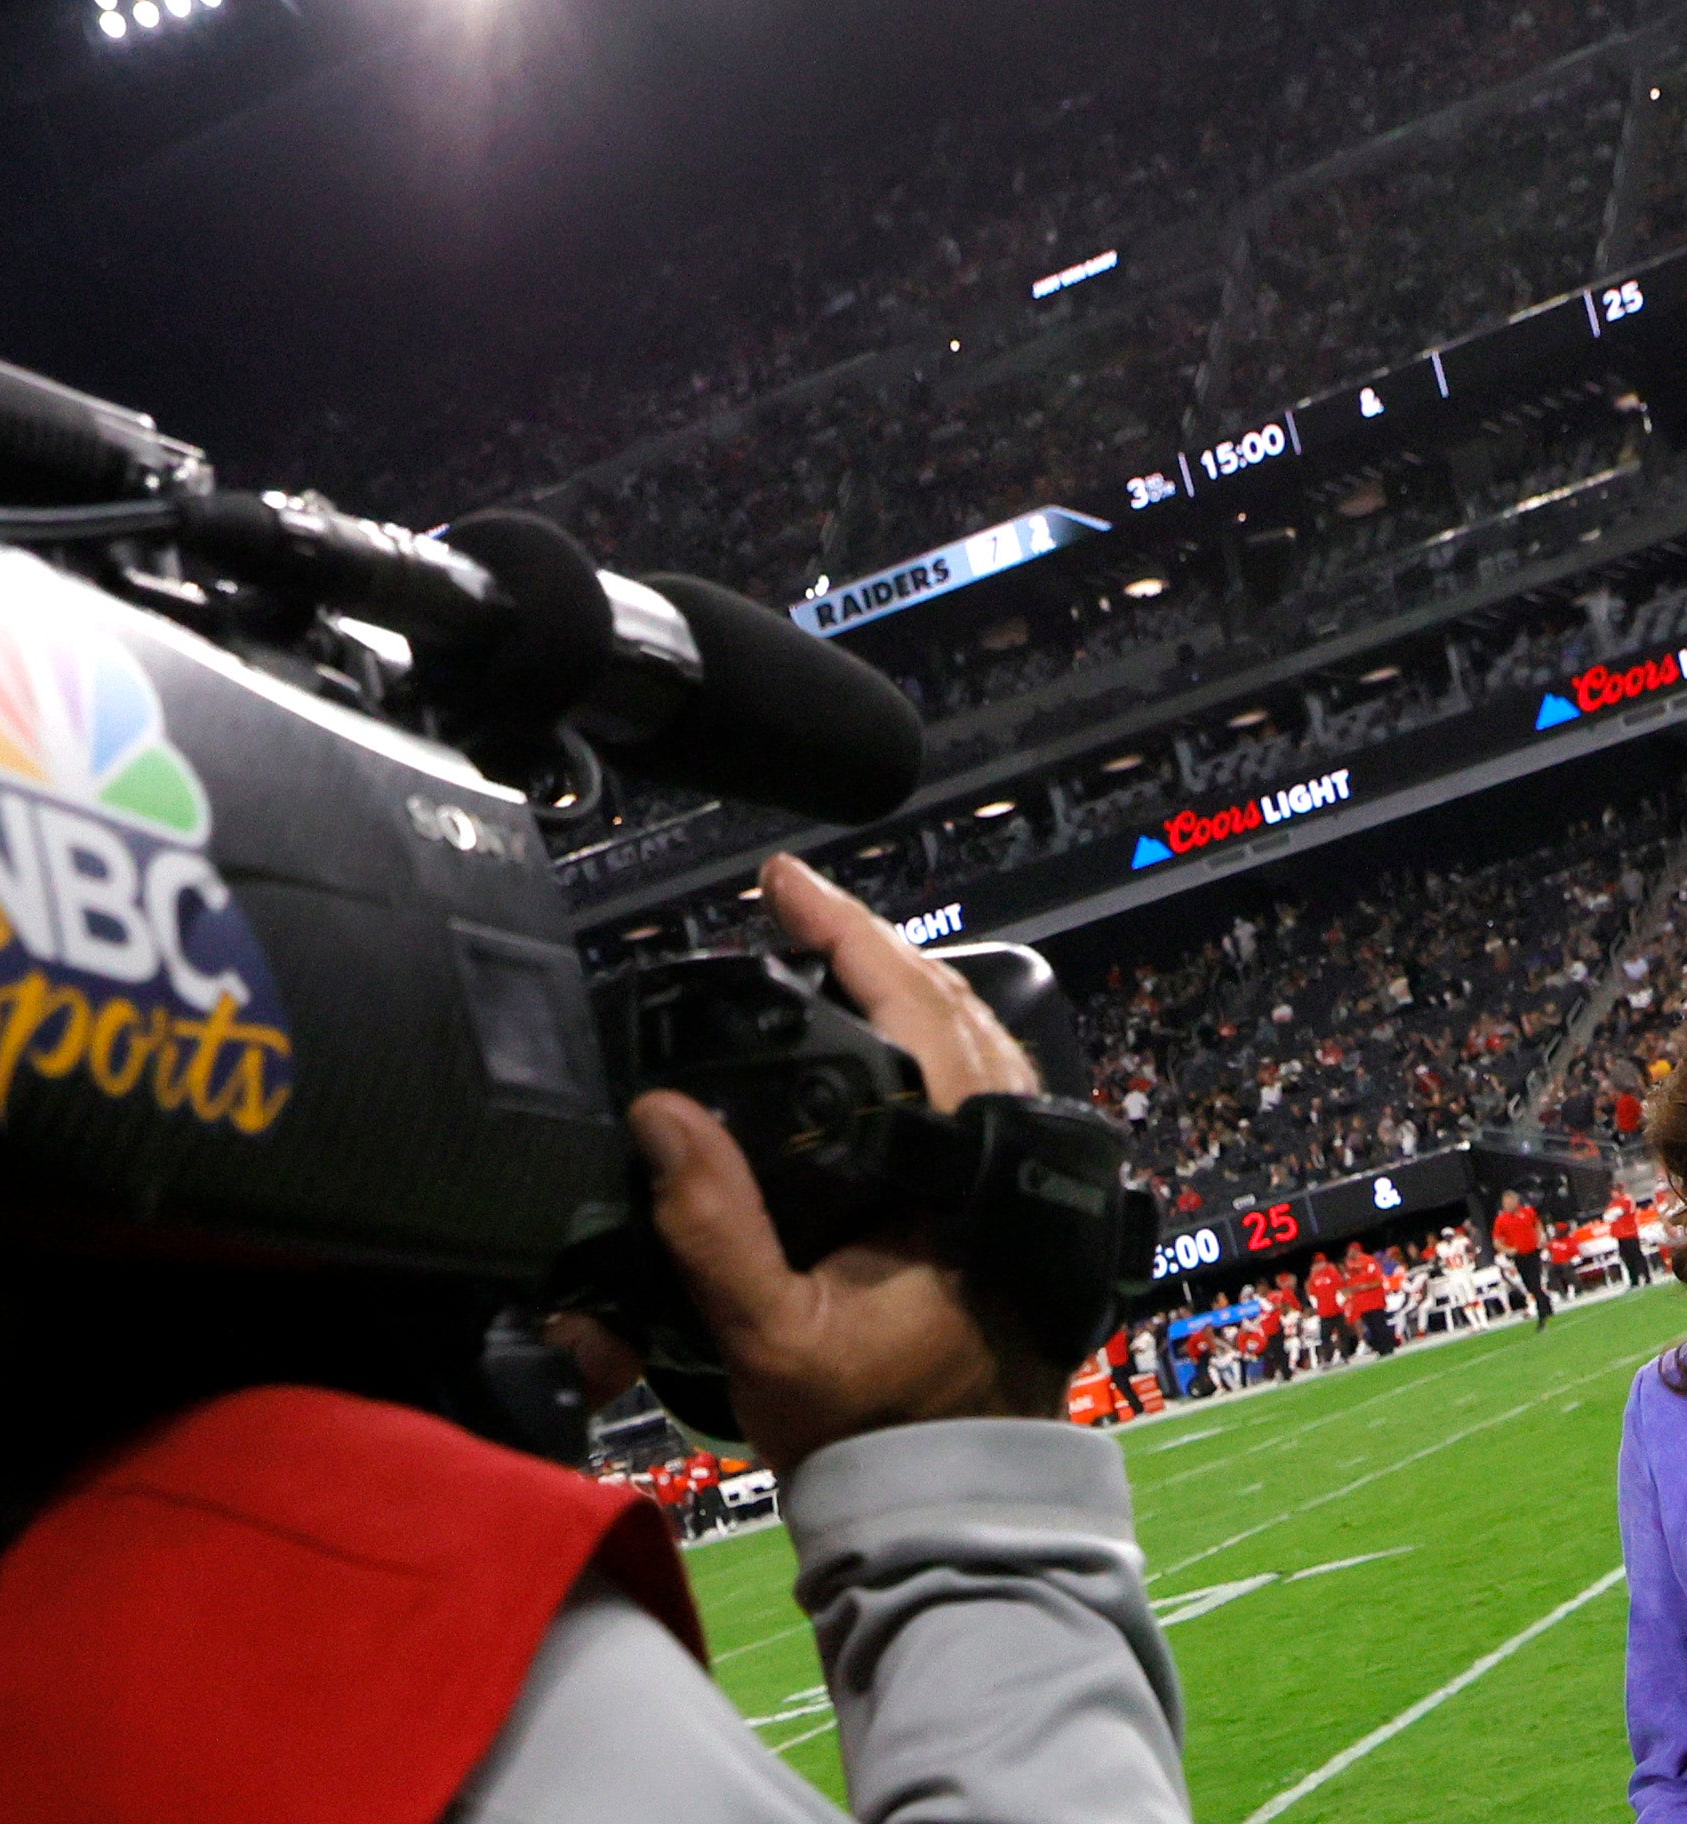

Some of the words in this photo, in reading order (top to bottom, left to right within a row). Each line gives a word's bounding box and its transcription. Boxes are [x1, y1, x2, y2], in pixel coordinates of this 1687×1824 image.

[1602, 280, 1644, 322] 25
[1200, 423, 1286, 480] 15:00
[1360, 387, 1384, 418] &
[815, 558, 952, 629] RAIDERS
[1571, 653, 1680, 712] Coors
[1164, 799, 1262, 854] Coors
[1260, 768, 1351, 825] LIGHT
[895, 902, 963, 946] IGHT
[1241, 1202, 1299, 1251] 25
[1373, 1176, 1403, 1210] &
